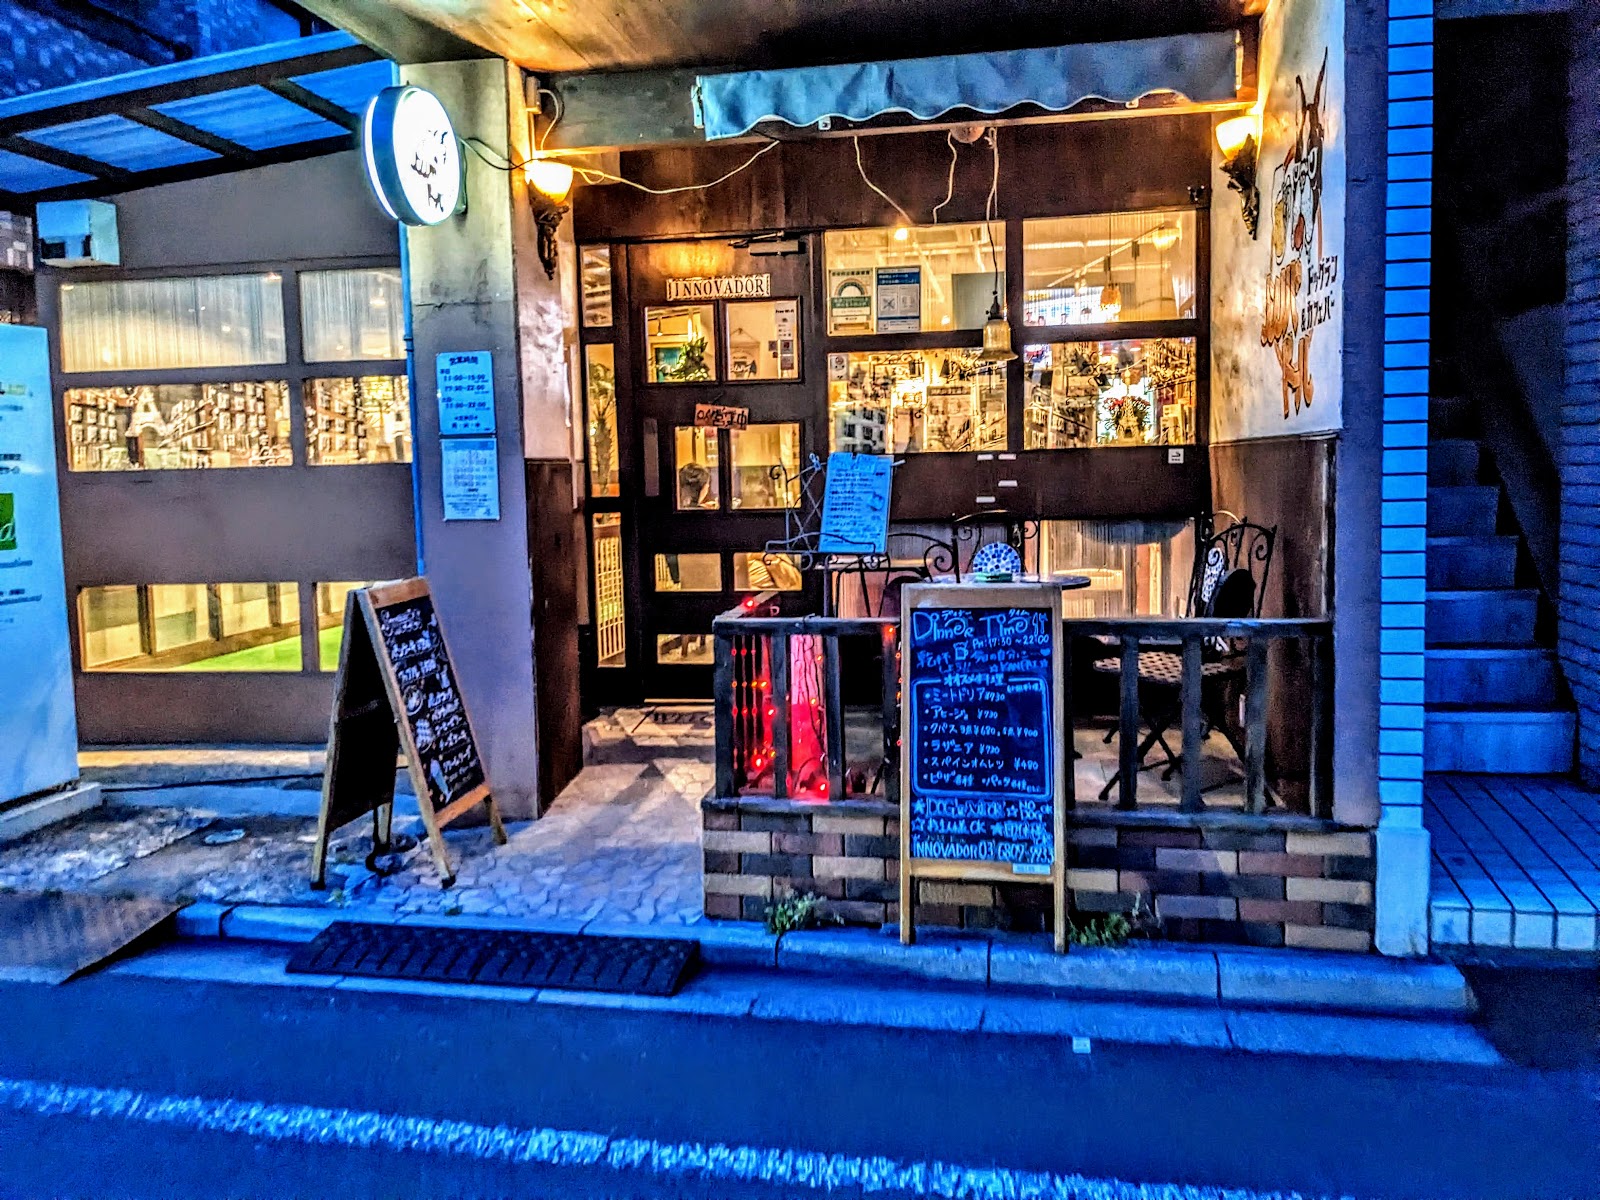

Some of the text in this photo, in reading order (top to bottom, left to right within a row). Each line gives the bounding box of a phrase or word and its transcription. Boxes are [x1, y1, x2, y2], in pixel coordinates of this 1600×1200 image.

[674, 278, 764, 297] INNOVADOR
[1307, 255, 1338, 296] ドッグラン
[979, 613, 1029, 638] Time
